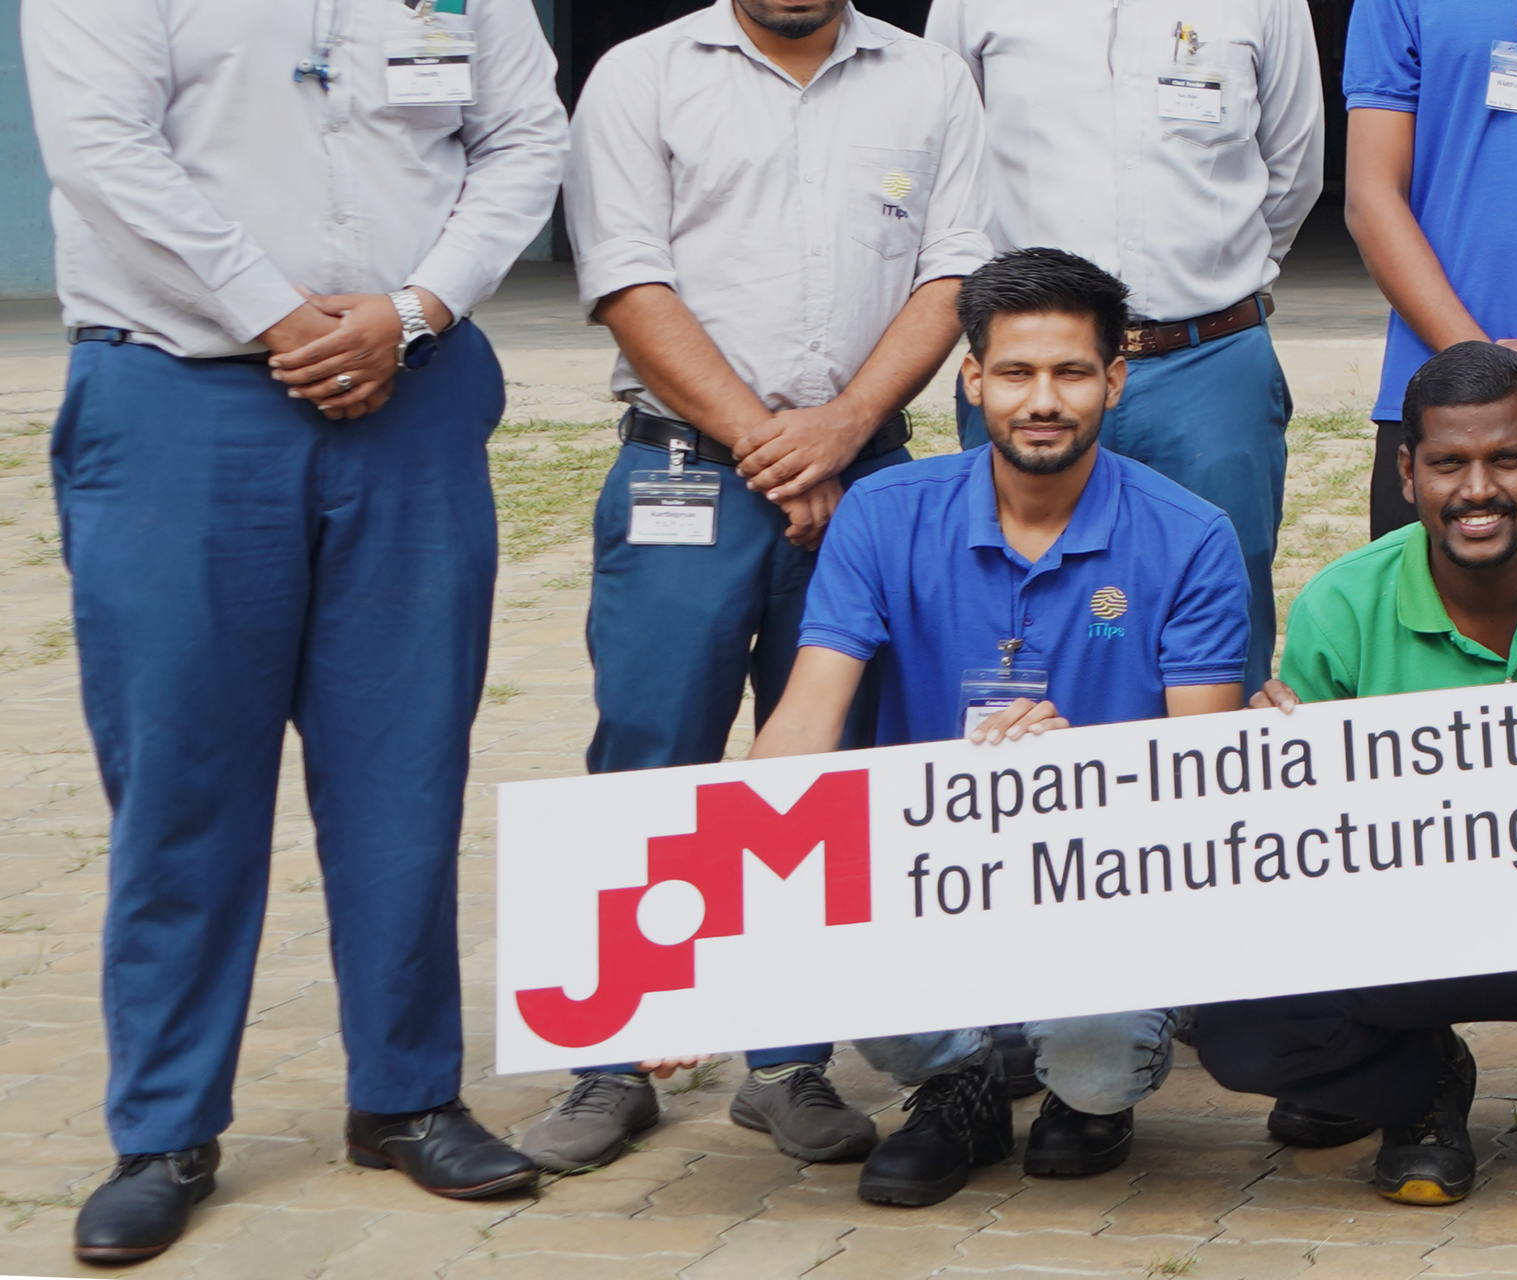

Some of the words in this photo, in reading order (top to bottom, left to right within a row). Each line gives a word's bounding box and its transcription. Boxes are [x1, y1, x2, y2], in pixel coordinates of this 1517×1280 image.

[882, 203, 909, 221] iTips
[1089, 623, 1125, 639] iTips
[902, 726, 1318, 834] Japan-India
[907, 852, 1004, 918] for
